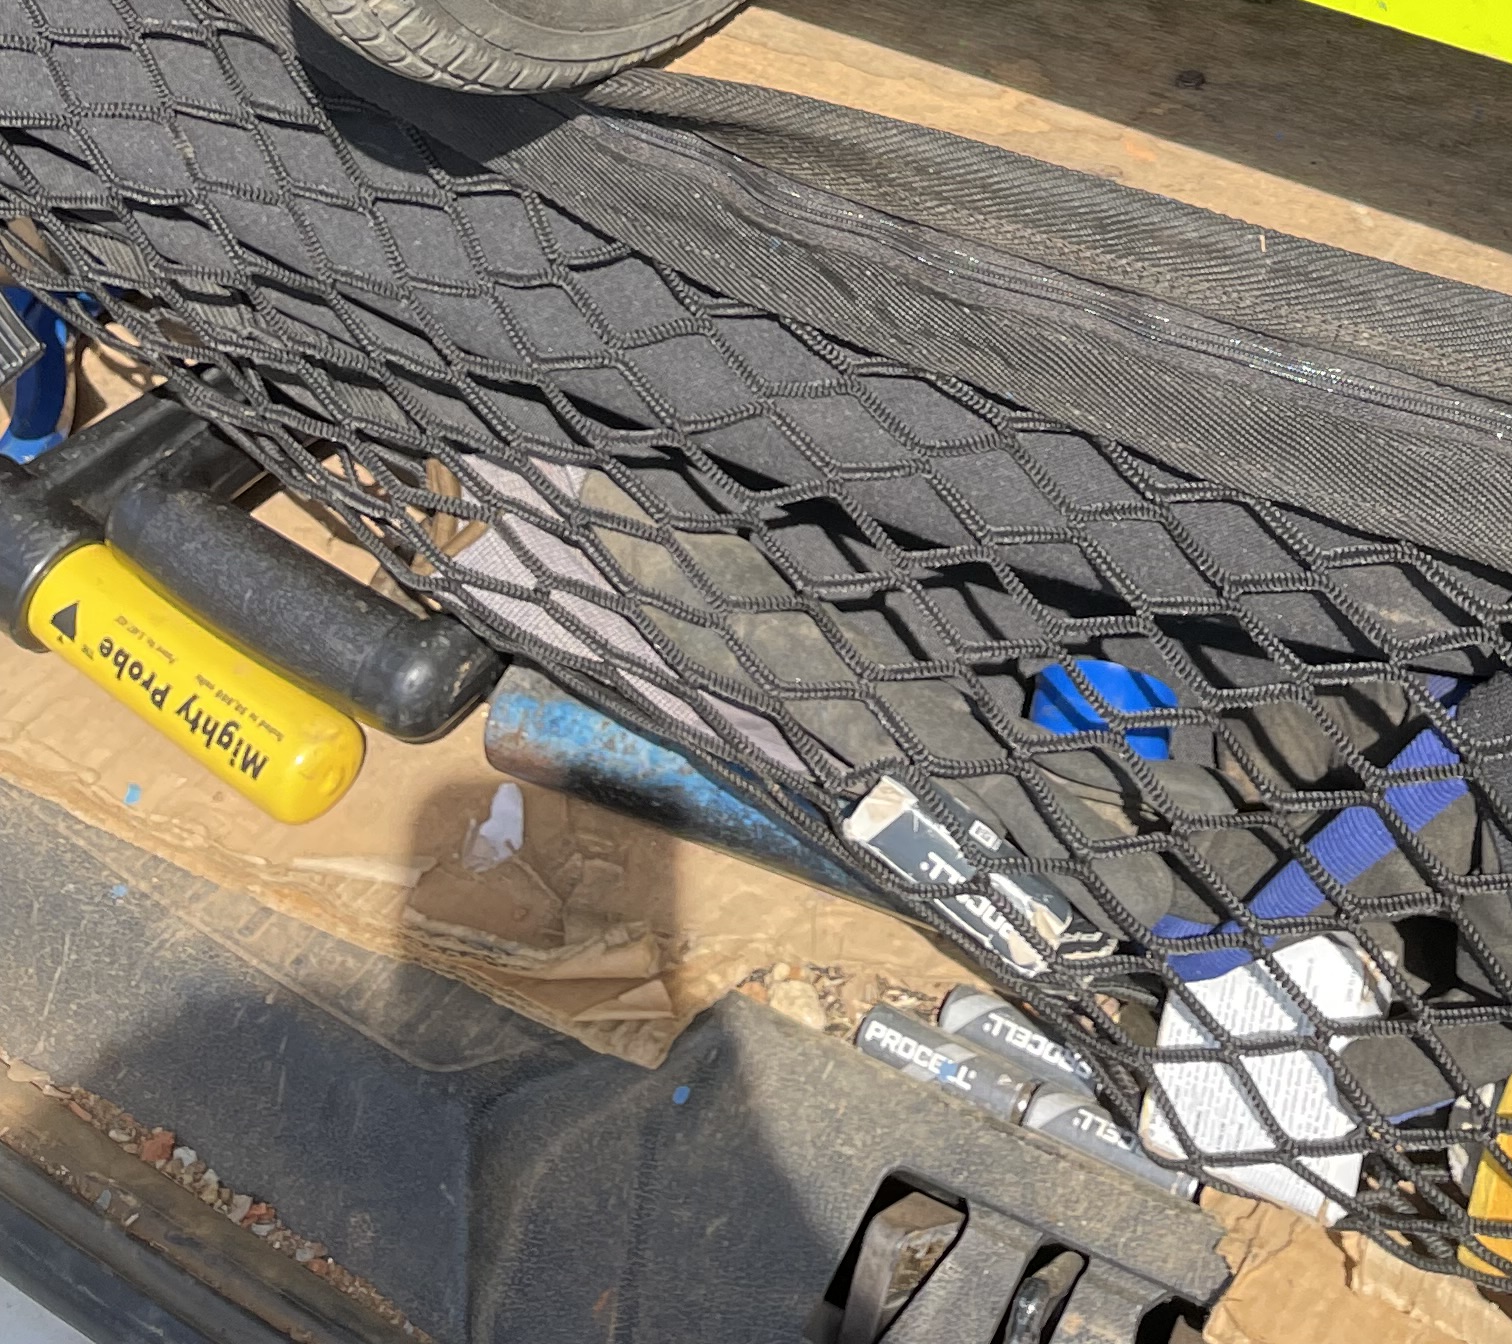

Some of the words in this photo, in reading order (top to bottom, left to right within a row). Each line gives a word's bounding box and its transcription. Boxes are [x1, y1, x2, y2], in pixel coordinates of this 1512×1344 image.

[98, 636, 173, 711] Probe
[175, 693, 269, 781] Mighty
[864, 1020, 972, 1091] PROCEL
